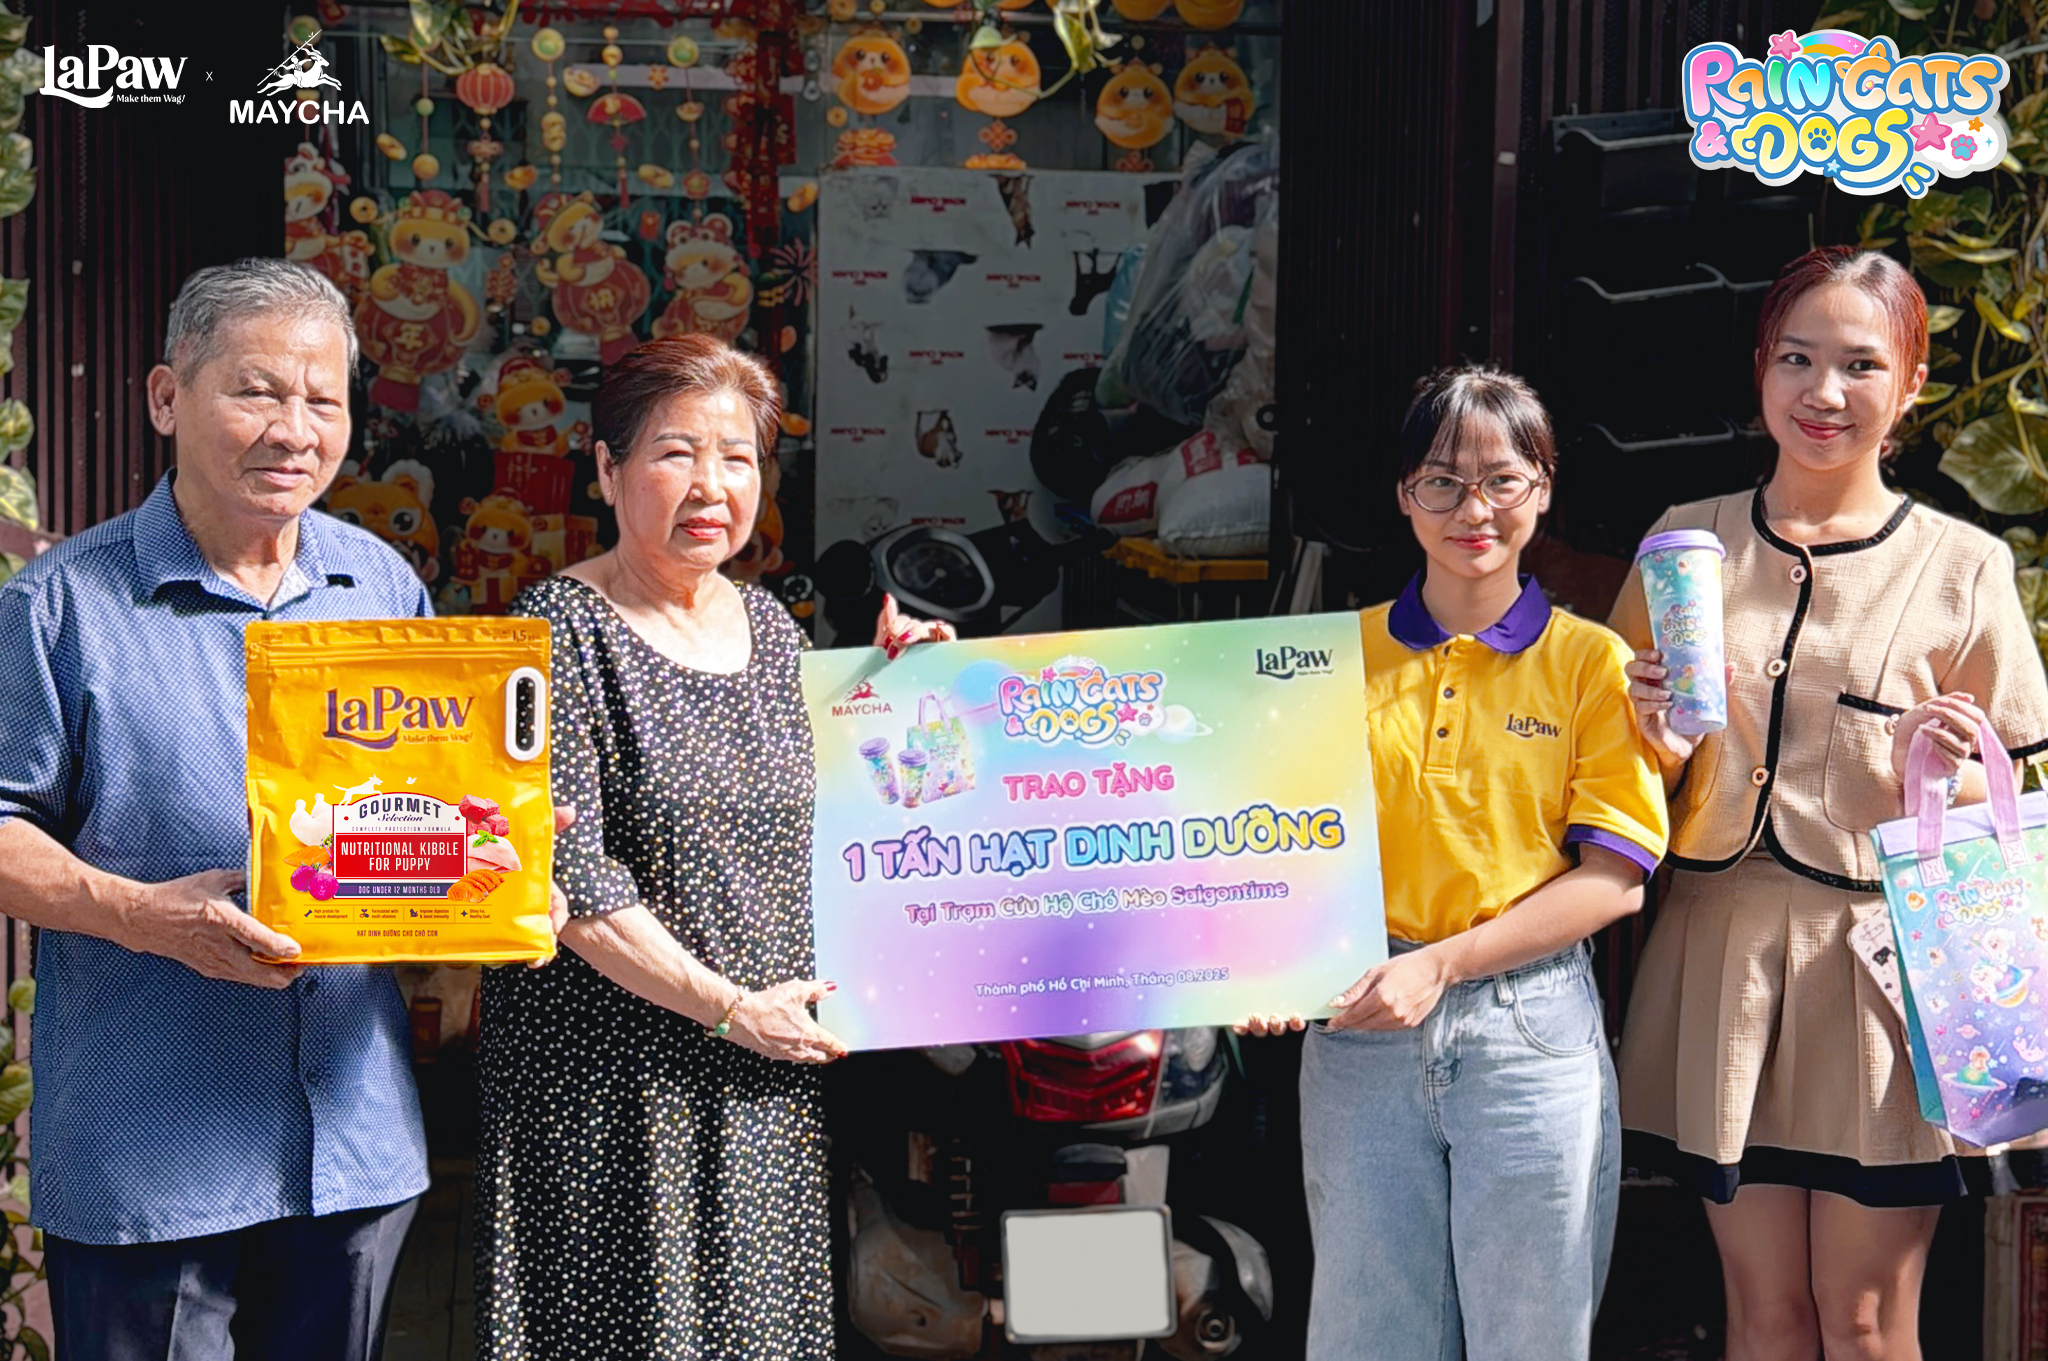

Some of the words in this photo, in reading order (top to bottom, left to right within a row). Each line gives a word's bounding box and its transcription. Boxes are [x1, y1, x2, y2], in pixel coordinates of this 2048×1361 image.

[394, 321, 424, 351] 年
[1256, 645, 1333, 680] LaPaw
[322, 685, 475, 750] LaPaw
[831, 702, 893, 717] MAYCHA
[1024, 701, 1118, 743] DOGS
[1505, 713, 1562, 738] LaPaw
[1002, 771, 1086, 802] TRAO
[1092, 762, 1175, 798] TẶNG
[359, 796, 442, 819] GOURMET
[377, 813, 423, 822] Selection
[341, 841, 415, 856] NUTRITIONAL
[420, 841, 459, 856] KIBBLE
[843, 842, 866, 882] 1
[871, 825, 962, 879] TẤN
[968, 830, 1057, 877] HẠT
[1064, 820, 1175, 866] DINH
[1181, 804, 1346, 859] DƯỠNG
[369, 857, 390, 871] FOR
[395, 857, 431, 871] PUPPY
[358, 885, 371, 895] DOG
[372, 885, 392, 895] UNDER
[393, 885, 400, 895] 12
[402, 885, 428, 895] MONTHS
[429, 885, 441, 895] OLD
[905, 903, 937, 926] Tại
[940, 901, 996, 922] Trạm
[999, 896, 1039, 917] Cứu
[1042, 892, 1074, 917] Hộ
[1076, 889, 1119, 912] Chó
[1121, 887, 1168, 909] Mèo
[1170, 881, 1289, 907] Saigontime
[976, 984, 1017, 997] Thành
[1019, 979, 1046, 996] phố
[1131, 971, 1174, 986] Tháng
